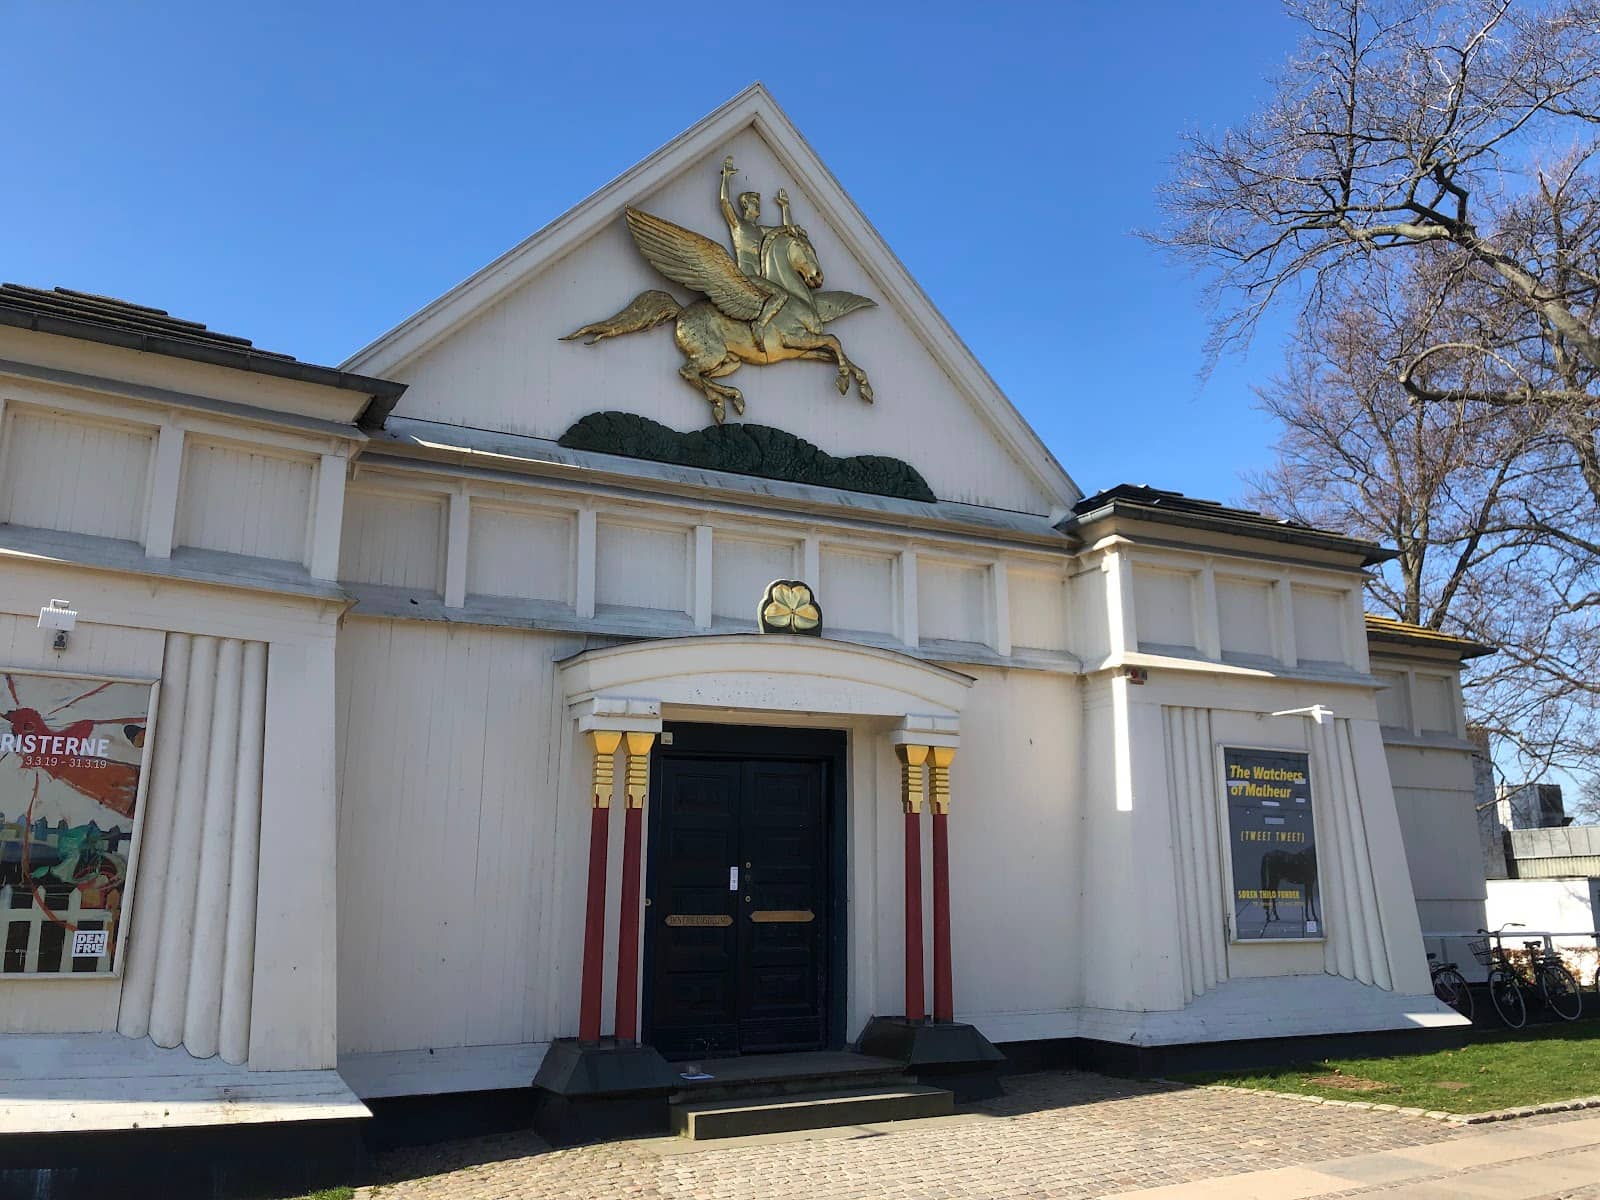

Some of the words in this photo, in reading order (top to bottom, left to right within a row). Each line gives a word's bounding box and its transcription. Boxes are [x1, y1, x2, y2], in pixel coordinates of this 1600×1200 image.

[0, 733, 110, 757] RISTERNE
[69, 758, 107, 769] 31.3.19
[1229, 765, 1251, 780] The
[1253, 766, 1304, 782] Watchers
[1231, 784, 1245, 796] of
[1245, 784, 1292, 799] Malheur
[77, 934, 105, 944] DEN
[76, 943, 104, 953] FRIE
